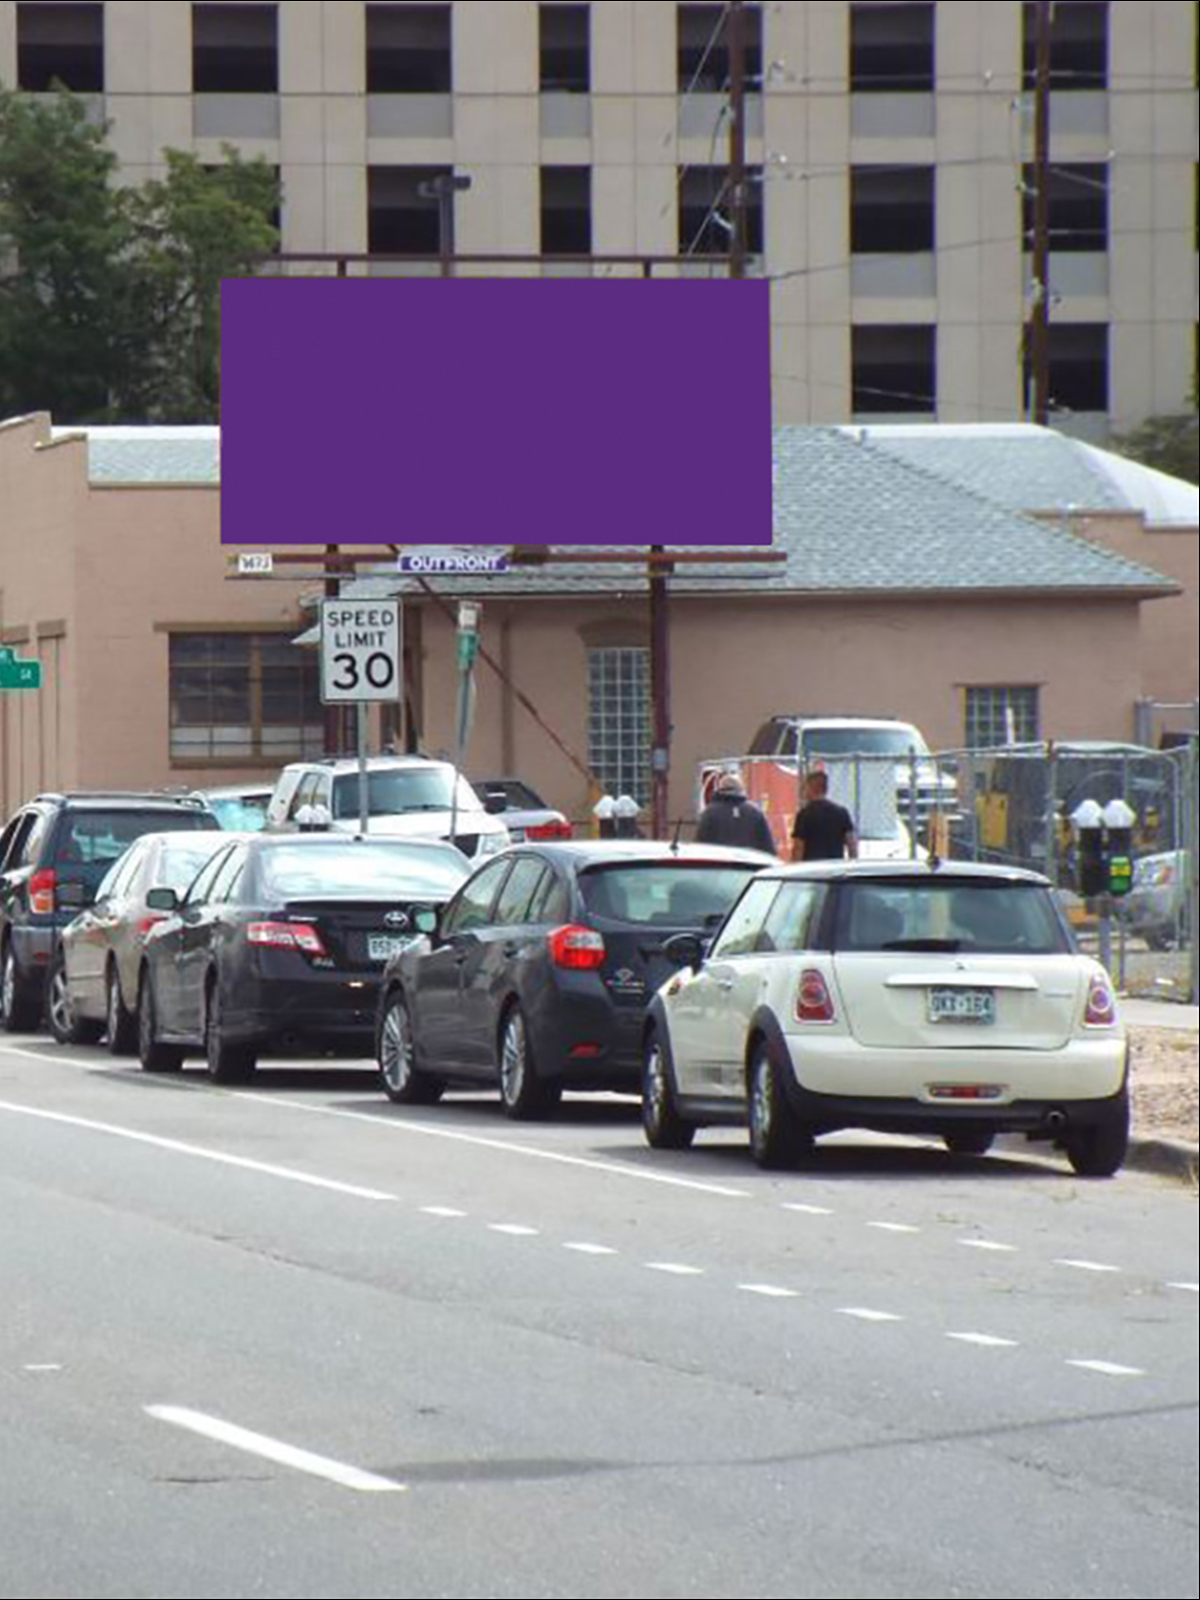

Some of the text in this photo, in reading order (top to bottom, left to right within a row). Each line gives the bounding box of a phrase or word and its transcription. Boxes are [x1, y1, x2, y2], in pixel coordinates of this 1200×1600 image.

[410, 555, 498, 571] OUTFRONT
[327, 608, 394, 627] SPEED
[334, 631, 387, 648] LIMIT
[333, 652, 394, 690] 30
